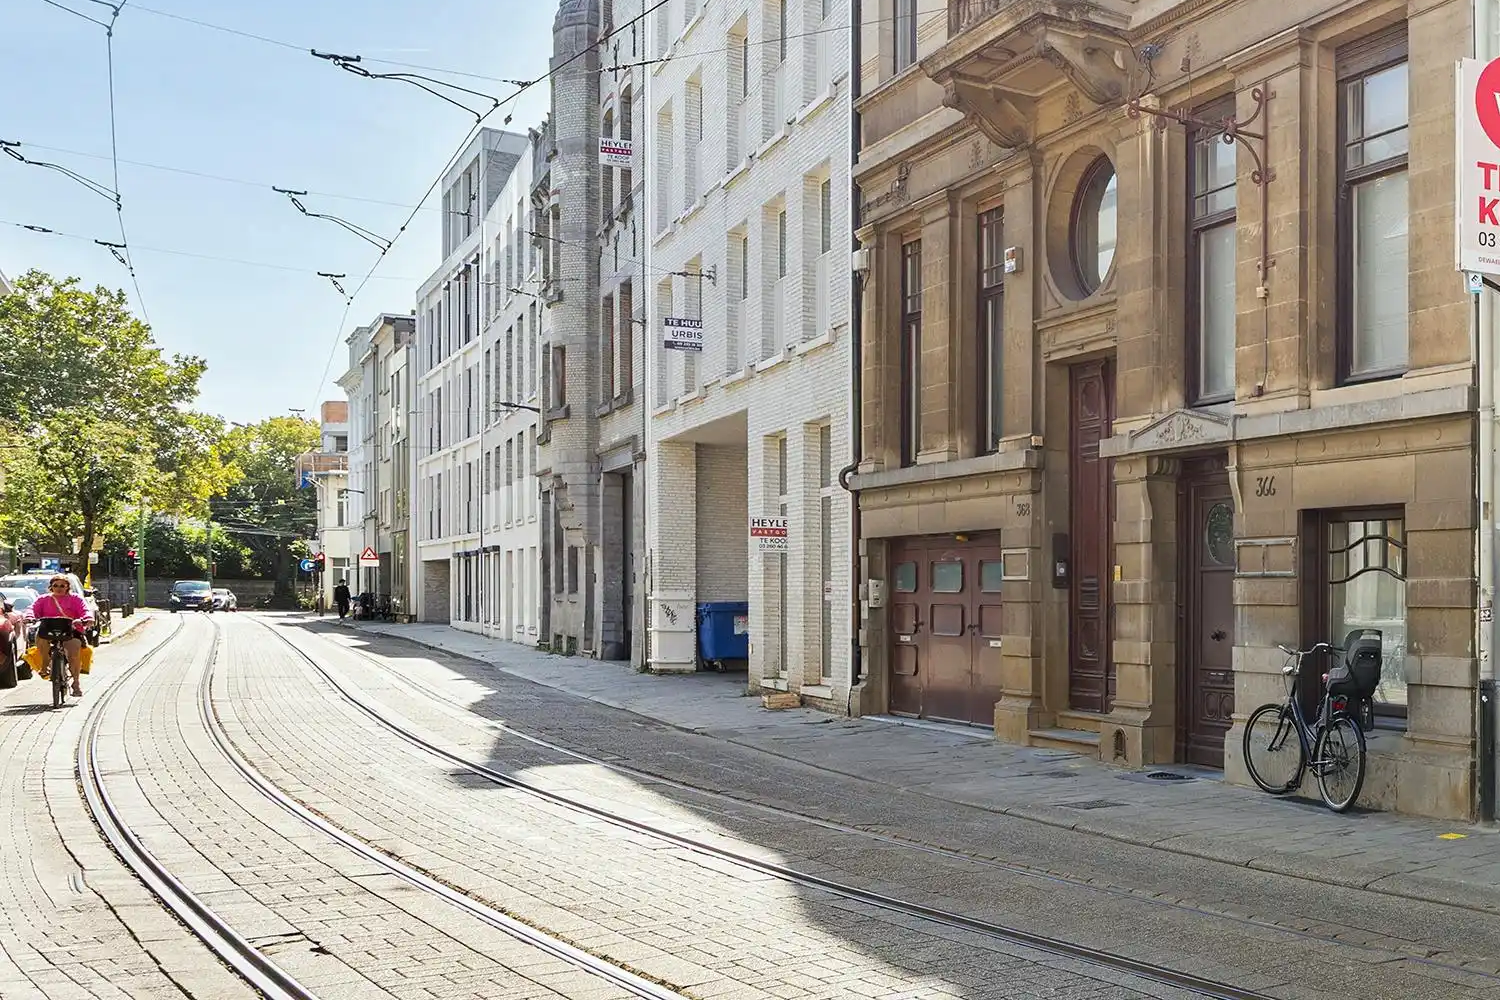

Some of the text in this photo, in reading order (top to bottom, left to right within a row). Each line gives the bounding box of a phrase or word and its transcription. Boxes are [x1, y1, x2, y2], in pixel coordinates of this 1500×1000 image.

[1478, 231, 1496, 248] 03
[671, 330, 703, 340] URBIS
[1256, 475, 1276, 497] 366
